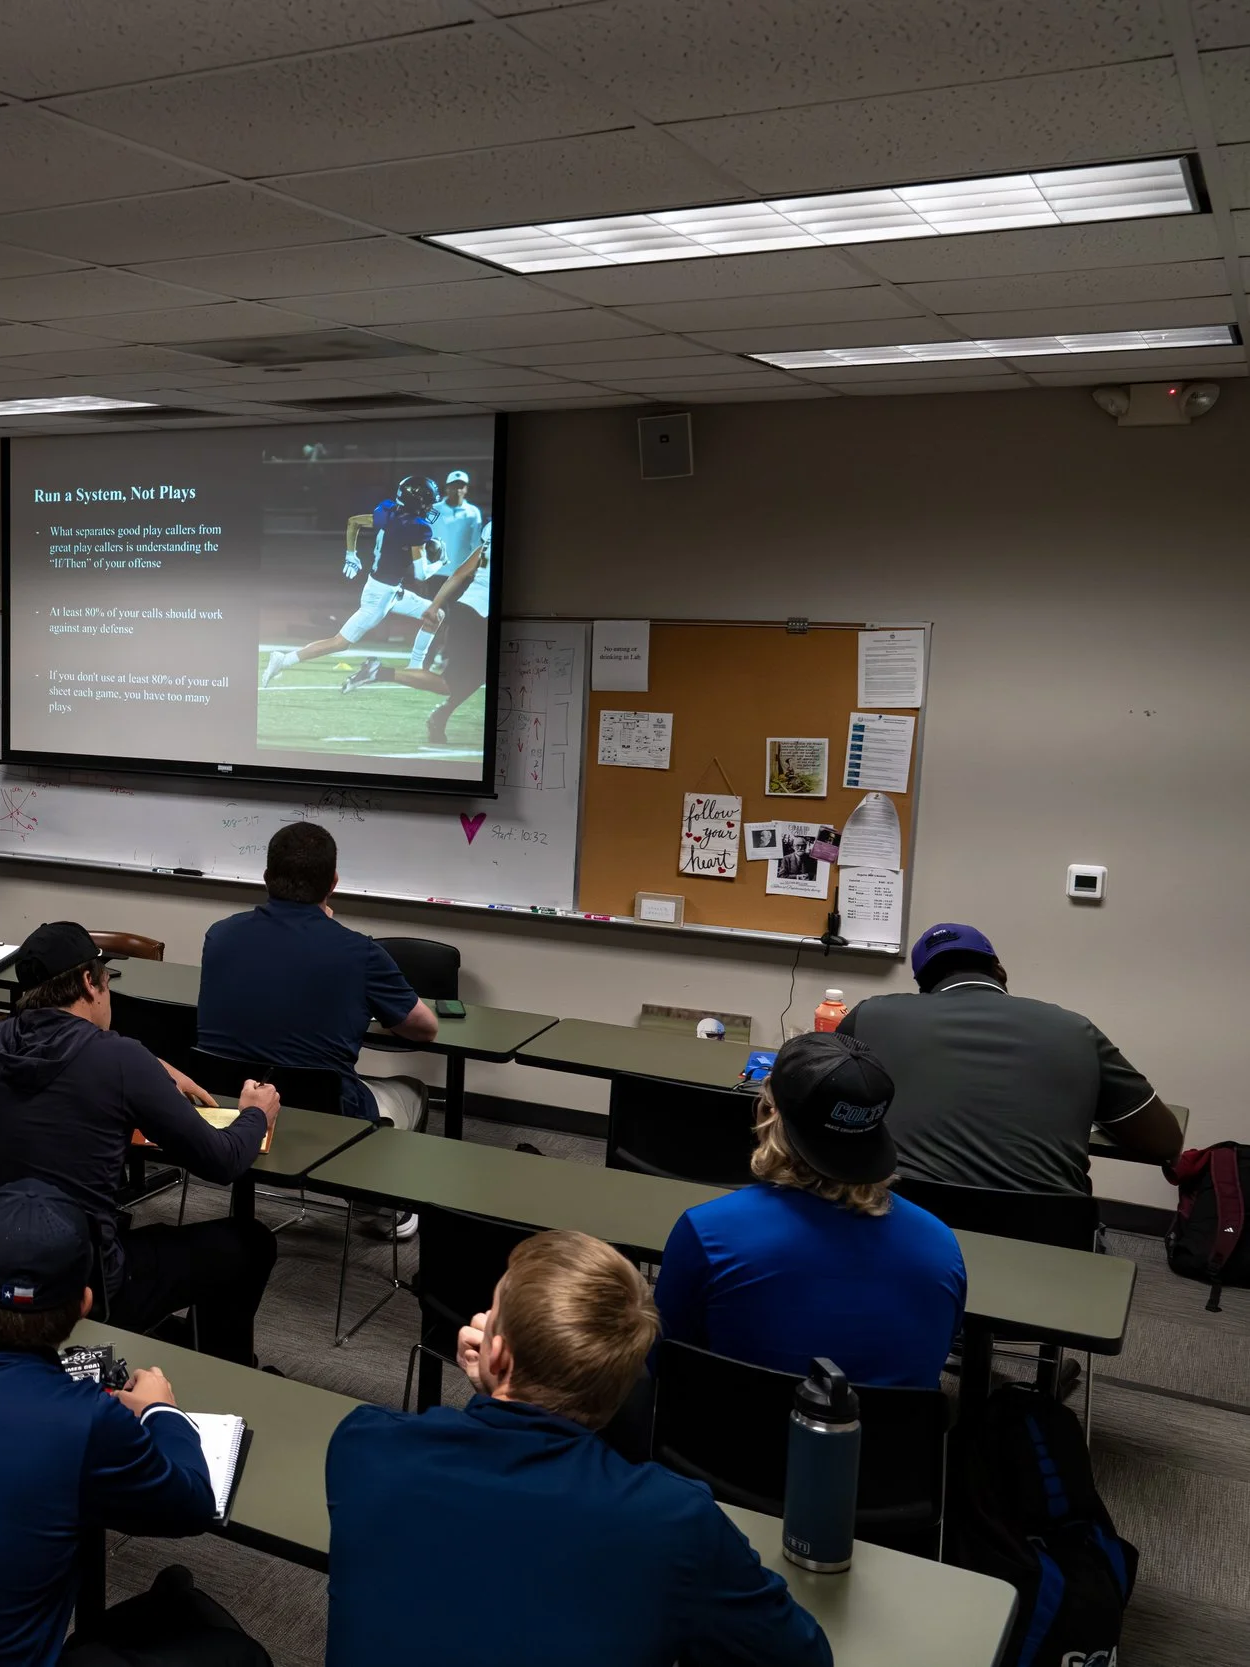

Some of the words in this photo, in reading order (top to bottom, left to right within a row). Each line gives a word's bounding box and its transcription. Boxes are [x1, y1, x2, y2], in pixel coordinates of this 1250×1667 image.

[34, 489, 61, 503] Run
[64, 491, 73, 502] a
[75, 487, 126, 505] System,
[131, 486, 155, 501] Not
[159, 485, 197, 503] Plays
[50, 526, 73, 537] What
[75, 527, 116, 539] separates
[117, 525, 140, 538] good
[143, 525, 163, 538] play
[165, 525, 196, 536] callers
[198, 524, 222, 535] from
[49, 543, 71, 555] great
[73, 542, 92, 554] play
[94, 542, 123, 552] callers
[126, 542, 134, 552] is
[136, 541, 201, 554] understanding
[204, 541, 218, 552] the
[93, 558, 104, 568] of
[105, 560, 126, 571] your
[128, 558, 162, 568] offense
[49, 607, 60, 617] At
[63, 607, 82, 617] least
[84, 608, 104, 618] 80%
[106, 608, 117, 618] of
[118, 610, 140, 620] your
[141, 608, 163, 618] calls
[165, 608, 196, 619] should
[199, 608, 223, 620] work
[49, 624, 80, 635] against
[81, 626, 98, 635] any
[100, 624, 134, 634] defense
[49, 670, 58, 680] If
[58, 673, 75, 683] you
[77, 672, 99, 682] don't
[101, 674, 115, 683] use
[117, 674, 126, 683] at
[128, 673, 149, 684] least
[151, 675, 173, 685] 80%
[175, 676, 185, 686] of
[187, 678, 210, 689] your
[211, 676, 229, 687] call
[49, 686, 71, 696] sheet
[73, 687, 93, 697] each
[123, 691, 142, 701] you
[143, 690, 165, 701] have
[167, 692, 182, 701] too
[184, 693, 210, 706] many
[49, 701, 72, 714] plays
[685, 799, 739, 832] follow
[521, 829, 549, 846] 10:32
[700, 827, 737, 849] your
[680, 845, 735, 872] heart
